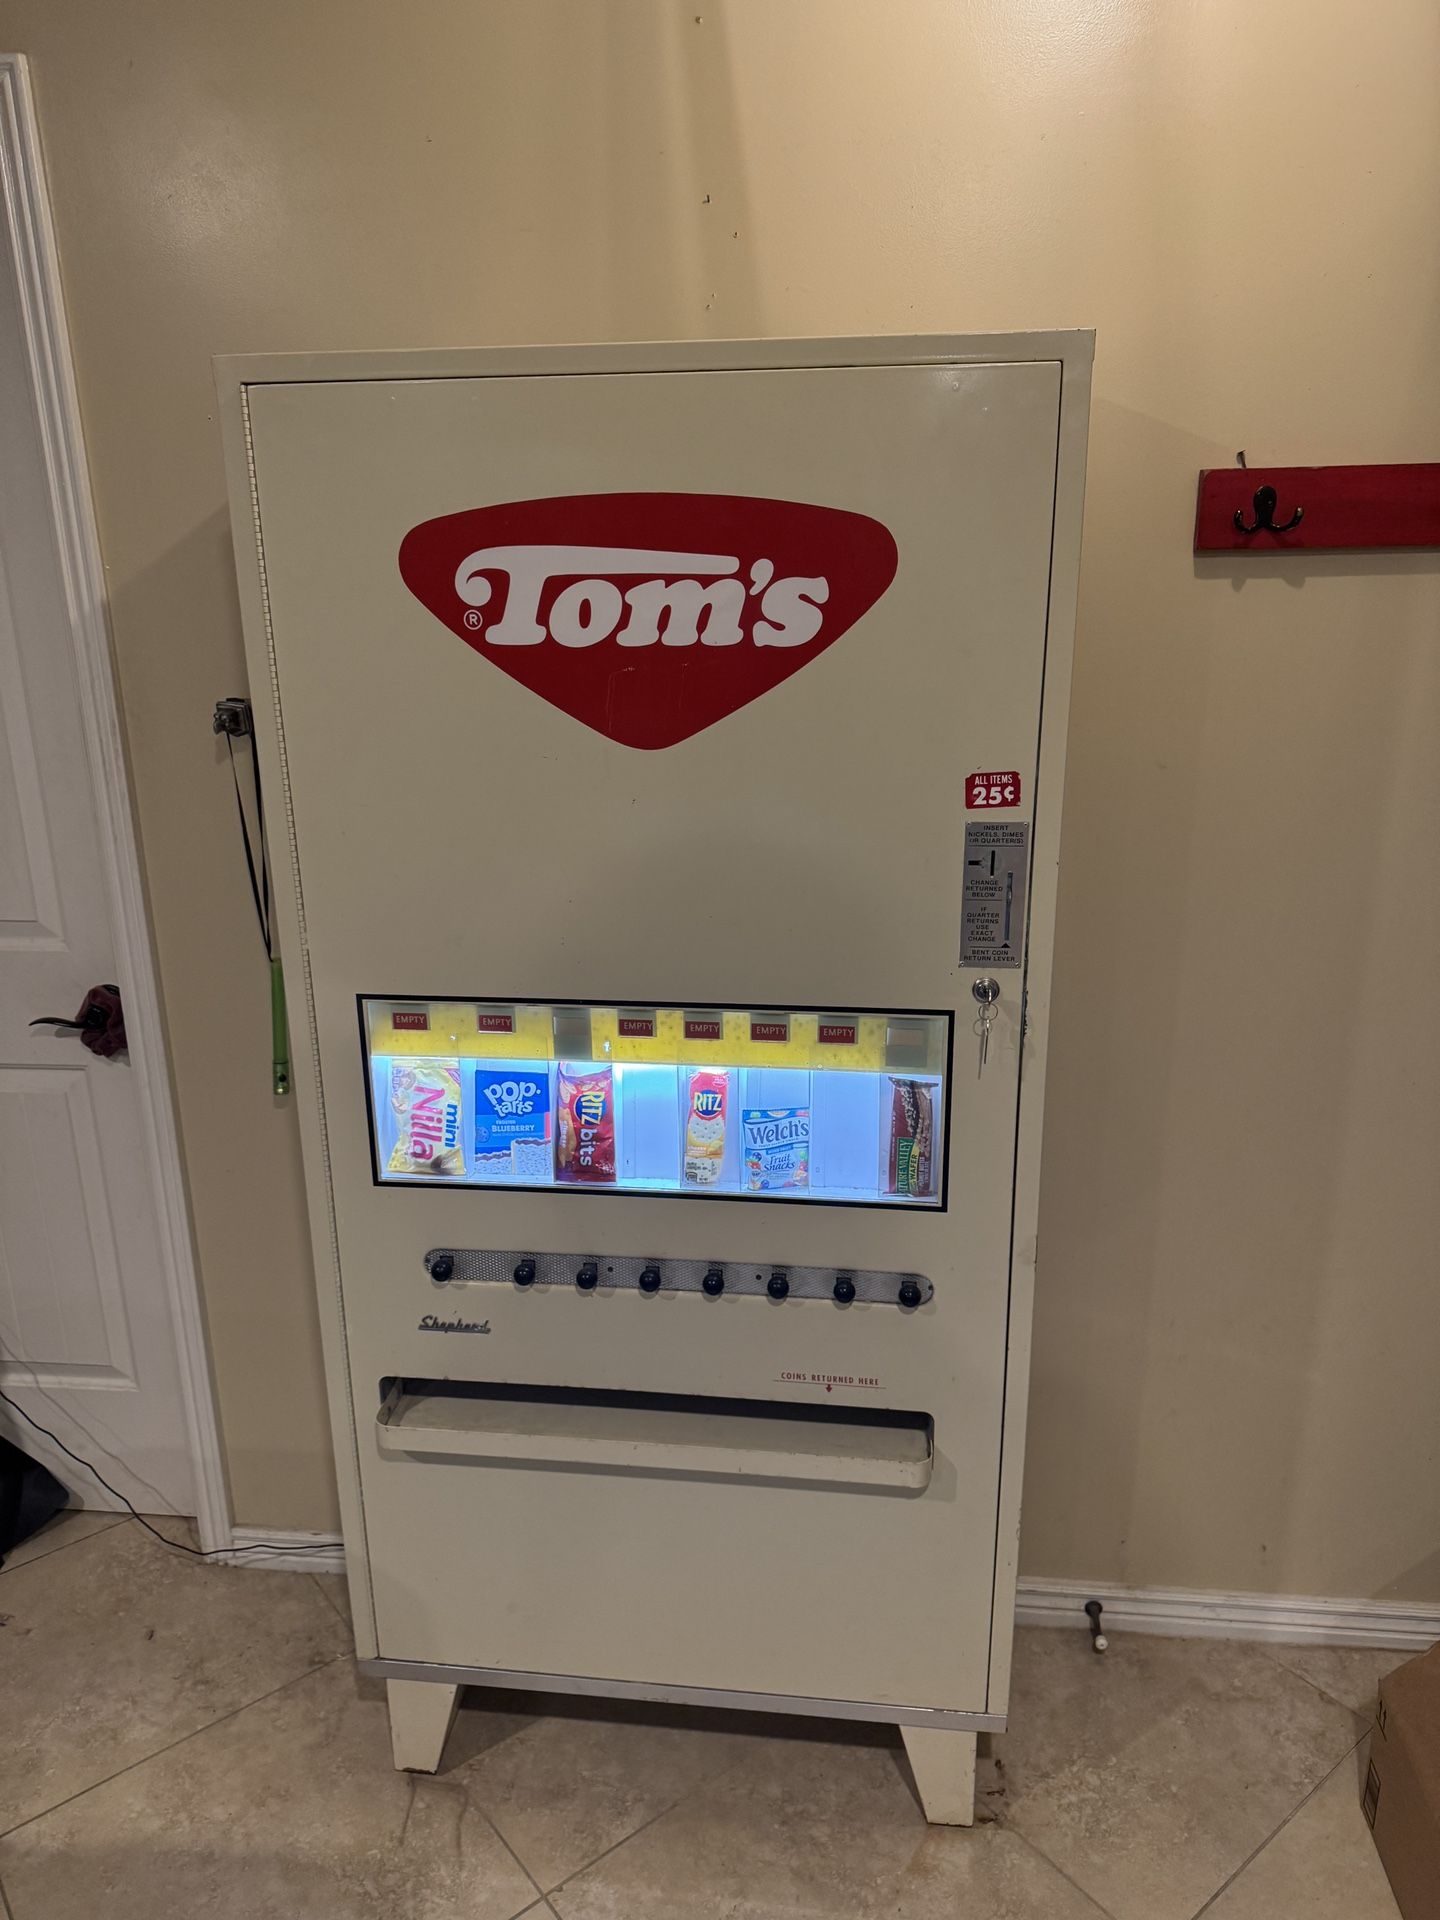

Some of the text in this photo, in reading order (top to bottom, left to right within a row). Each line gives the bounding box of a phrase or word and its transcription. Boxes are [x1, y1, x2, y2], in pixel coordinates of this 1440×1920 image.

[455, 545, 830, 648] Tom's
[974, 774, 1013, 785] ALL ITEMS
[972, 785, 1014, 805] 25¢
[395, 1015, 425, 1024] EMPTY
[482, 1017, 511, 1026] EMPTY
[623, 1021, 653, 1030] EMPTY
[690, 1023, 720, 1033] EMPTY
[756, 1026, 786, 1035] EMPTY
[823, 1028, 854, 1037] EMPTY
[494, 1100, 534, 1117] tarts
[693, 1092, 723, 1111] RITZ
[410, 1086, 445, 1160] Nilla
[445, 1103, 459, 1148] mini
[491, 1124, 535, 1133] BLUEBERRY
[580, 1091, 605, 1166] RITZ bits
[748, 1119, 809, 1145] Welch's
[769, 1153, 791, 1165] Fruit
[898, 1139, 913, 1169] VALLEY
[764, 1160, 796, 1171] Snacks
[910, 1154, 918, 1181] WAFER
[418, 1314, 491, 1335] Shepherd
[780, 1372, 880, 1386] COINS RETURNED HERE
